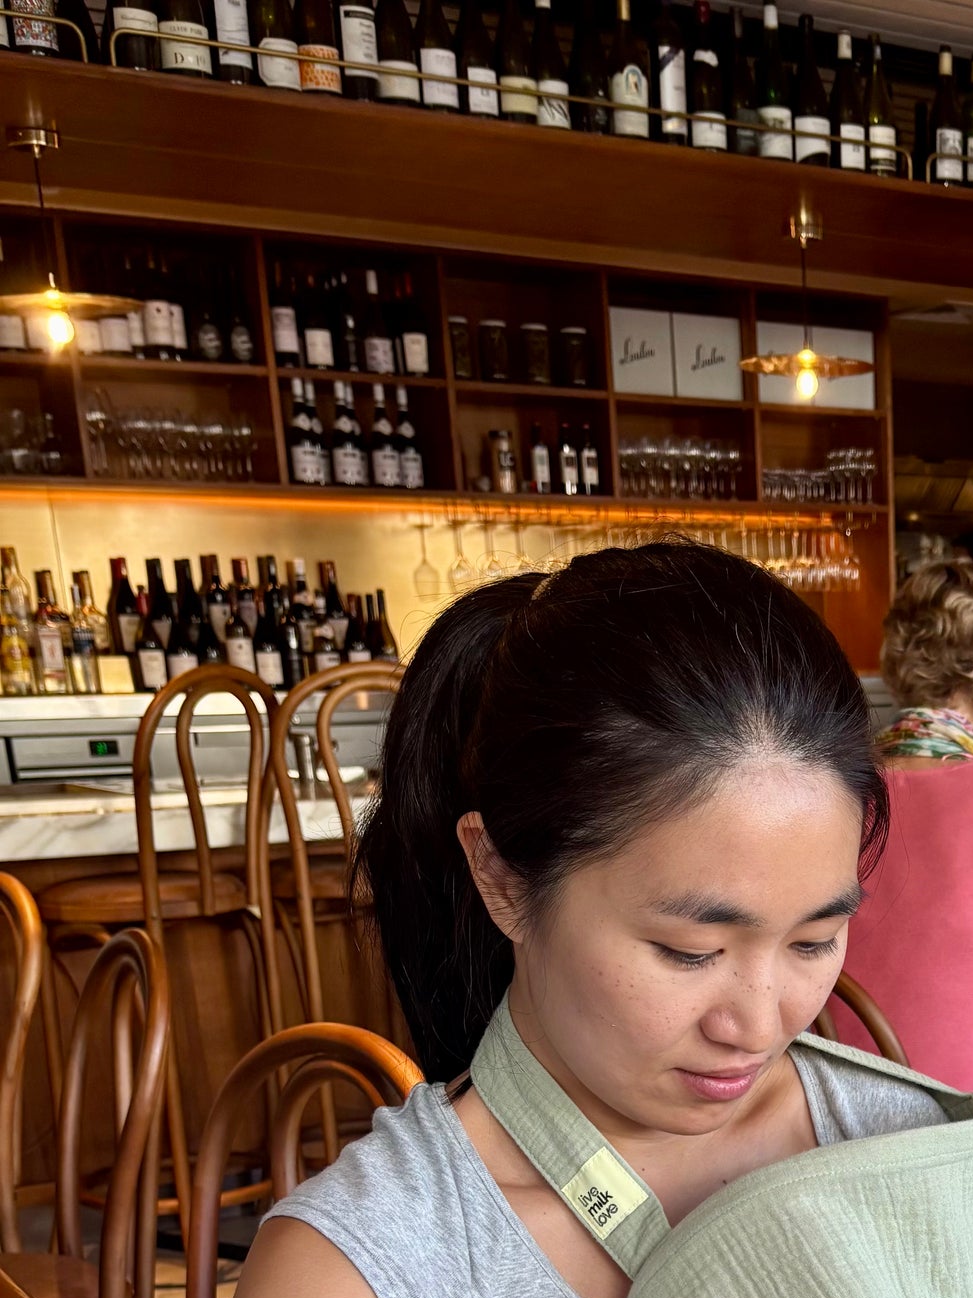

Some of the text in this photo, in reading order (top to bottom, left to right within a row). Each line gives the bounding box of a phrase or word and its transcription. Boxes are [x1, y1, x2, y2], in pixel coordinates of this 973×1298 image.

[577, 1186, 600, 1208] live
[588, 1190, 614, 1218] milk
[593, 1203, 619, 1228] love
